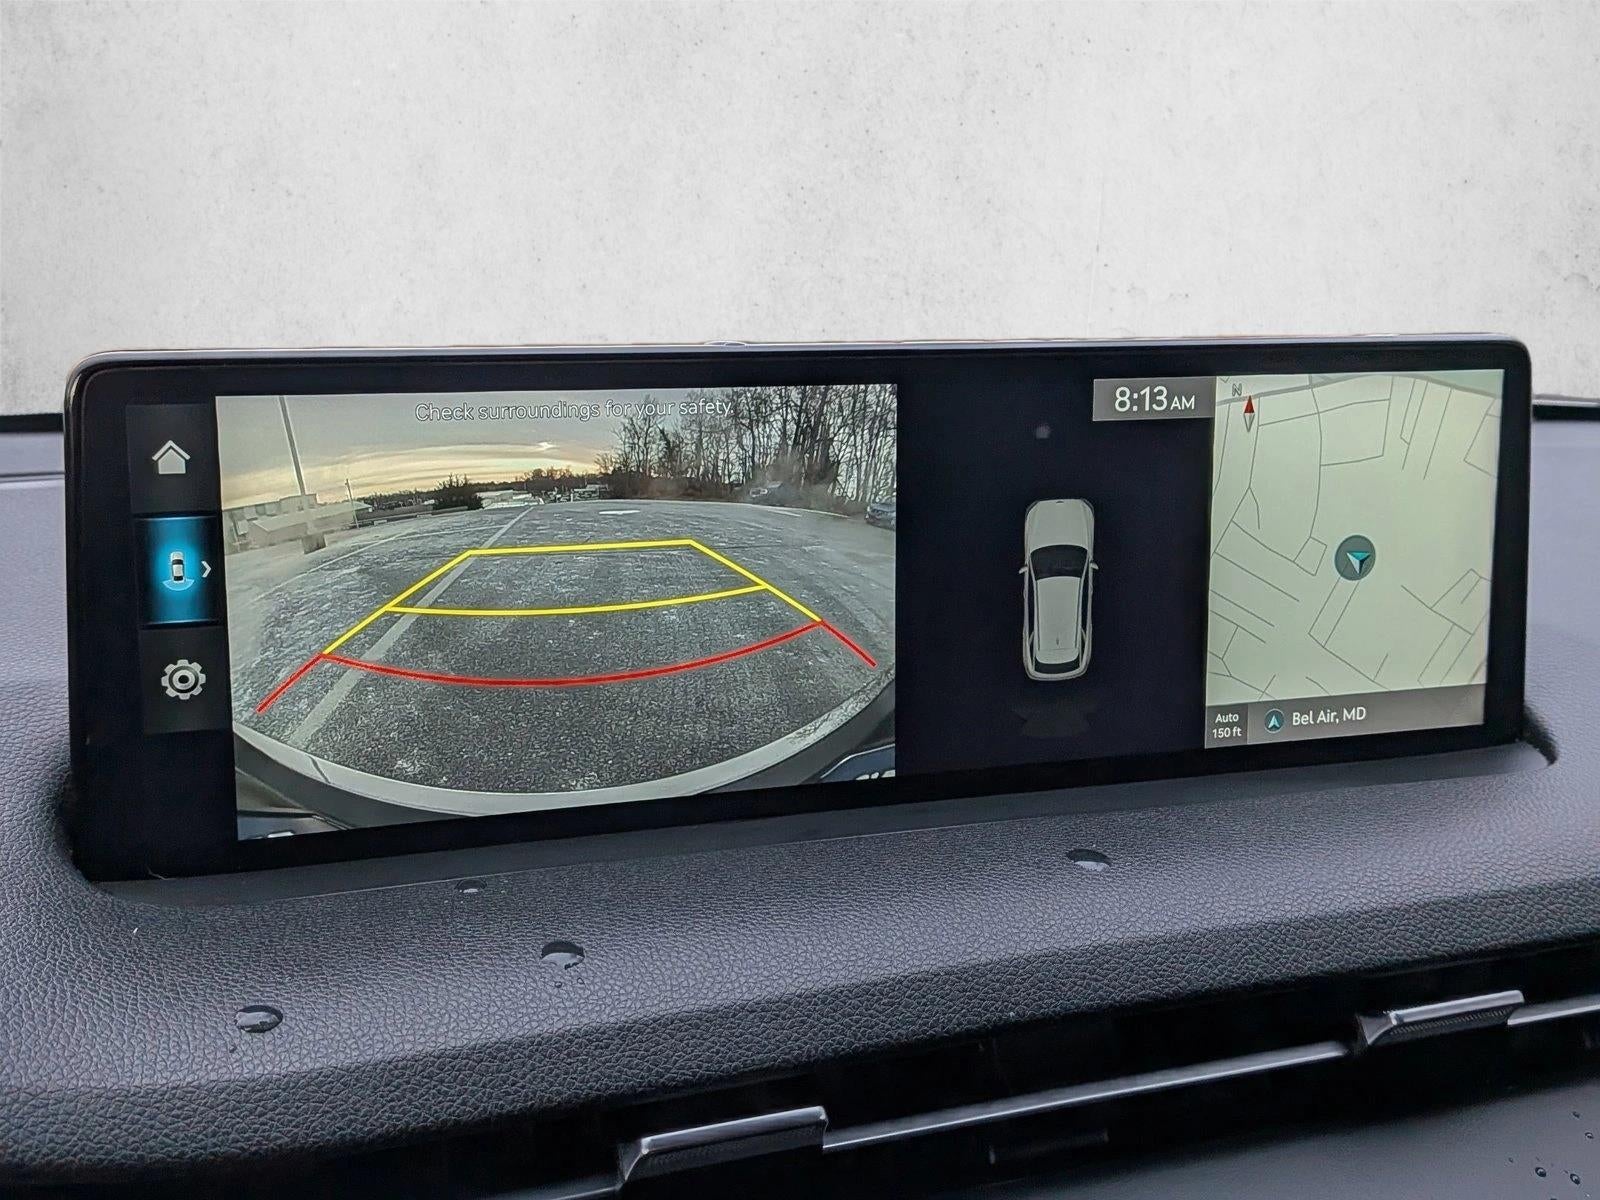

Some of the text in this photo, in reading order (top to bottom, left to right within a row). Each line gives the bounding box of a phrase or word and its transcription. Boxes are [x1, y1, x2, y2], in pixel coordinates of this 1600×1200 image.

[1231, 383, 1243, 396] N
[1114, 385, 1196, 412] 8:13 AM
[415, 398, 735, 422] Check surroundings for your safety.
[1215, 713, 1239, 723] Auto
[1292, 707, 1367, 726] Bel Air, MD
[1212, 727, 1242, 738] 150 ft
